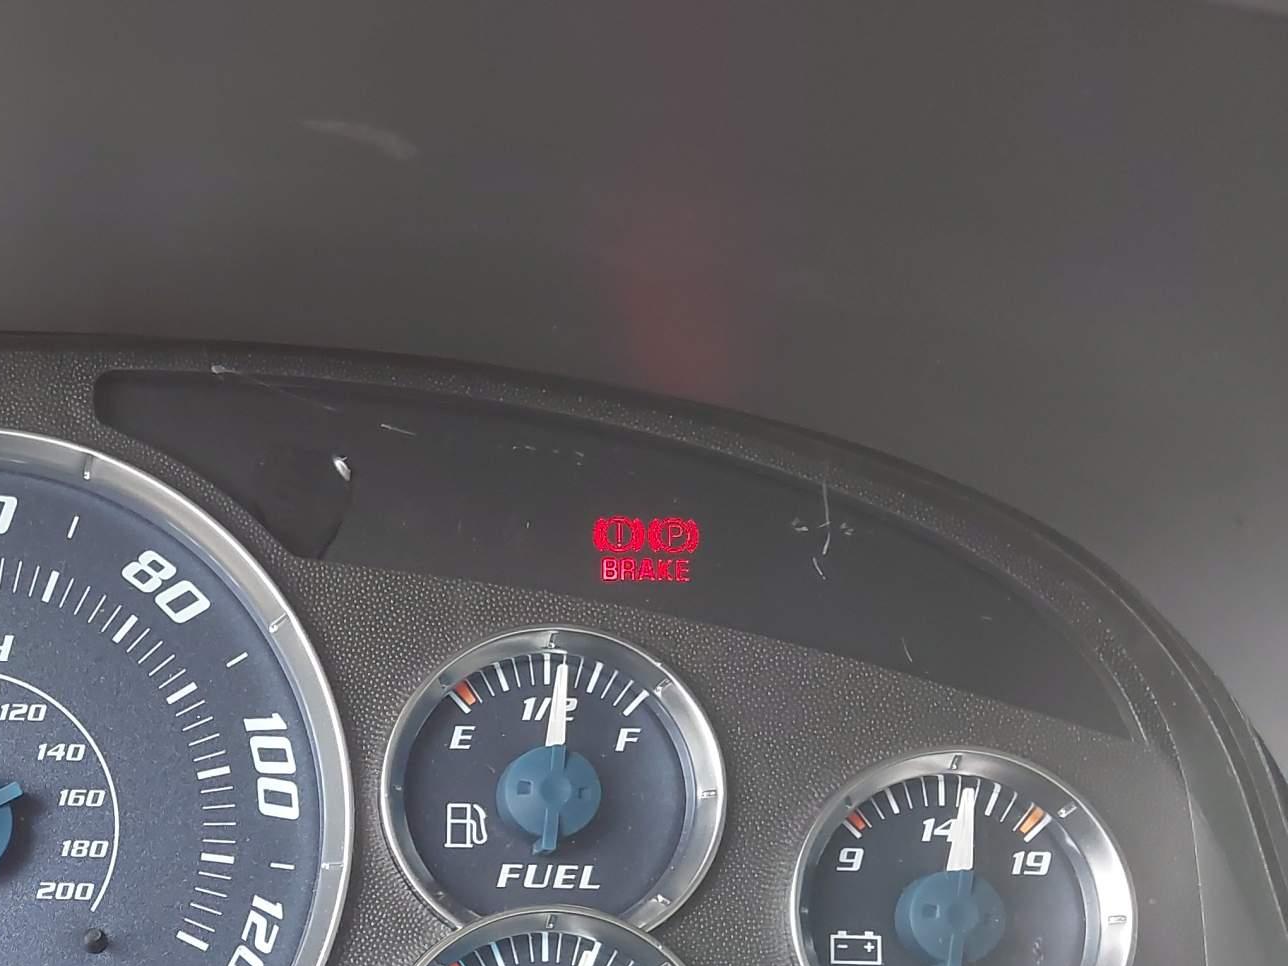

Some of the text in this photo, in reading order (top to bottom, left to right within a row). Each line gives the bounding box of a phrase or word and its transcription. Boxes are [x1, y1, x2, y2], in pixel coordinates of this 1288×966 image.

[601, 557, 691, 582] BRAKE
[121, 549, 210, 624] 80
[0, 704, 46, 722] 120
[449, 726, 475, 750] E
[615, 728, 641, 752] F
[37, 743, 86, 762] 140
[243, 712, 300, 819] 100
[58, 788, 105, 807] 160
[921, 818, 958, 843] 14
[61, 840, 109, 859] 180
[837, 848, 865, 872] 9
[1012, 850, 1052, 876] 19
[496, 863, 601, 890] FUEL
[36, 882, 95, 902] 200
